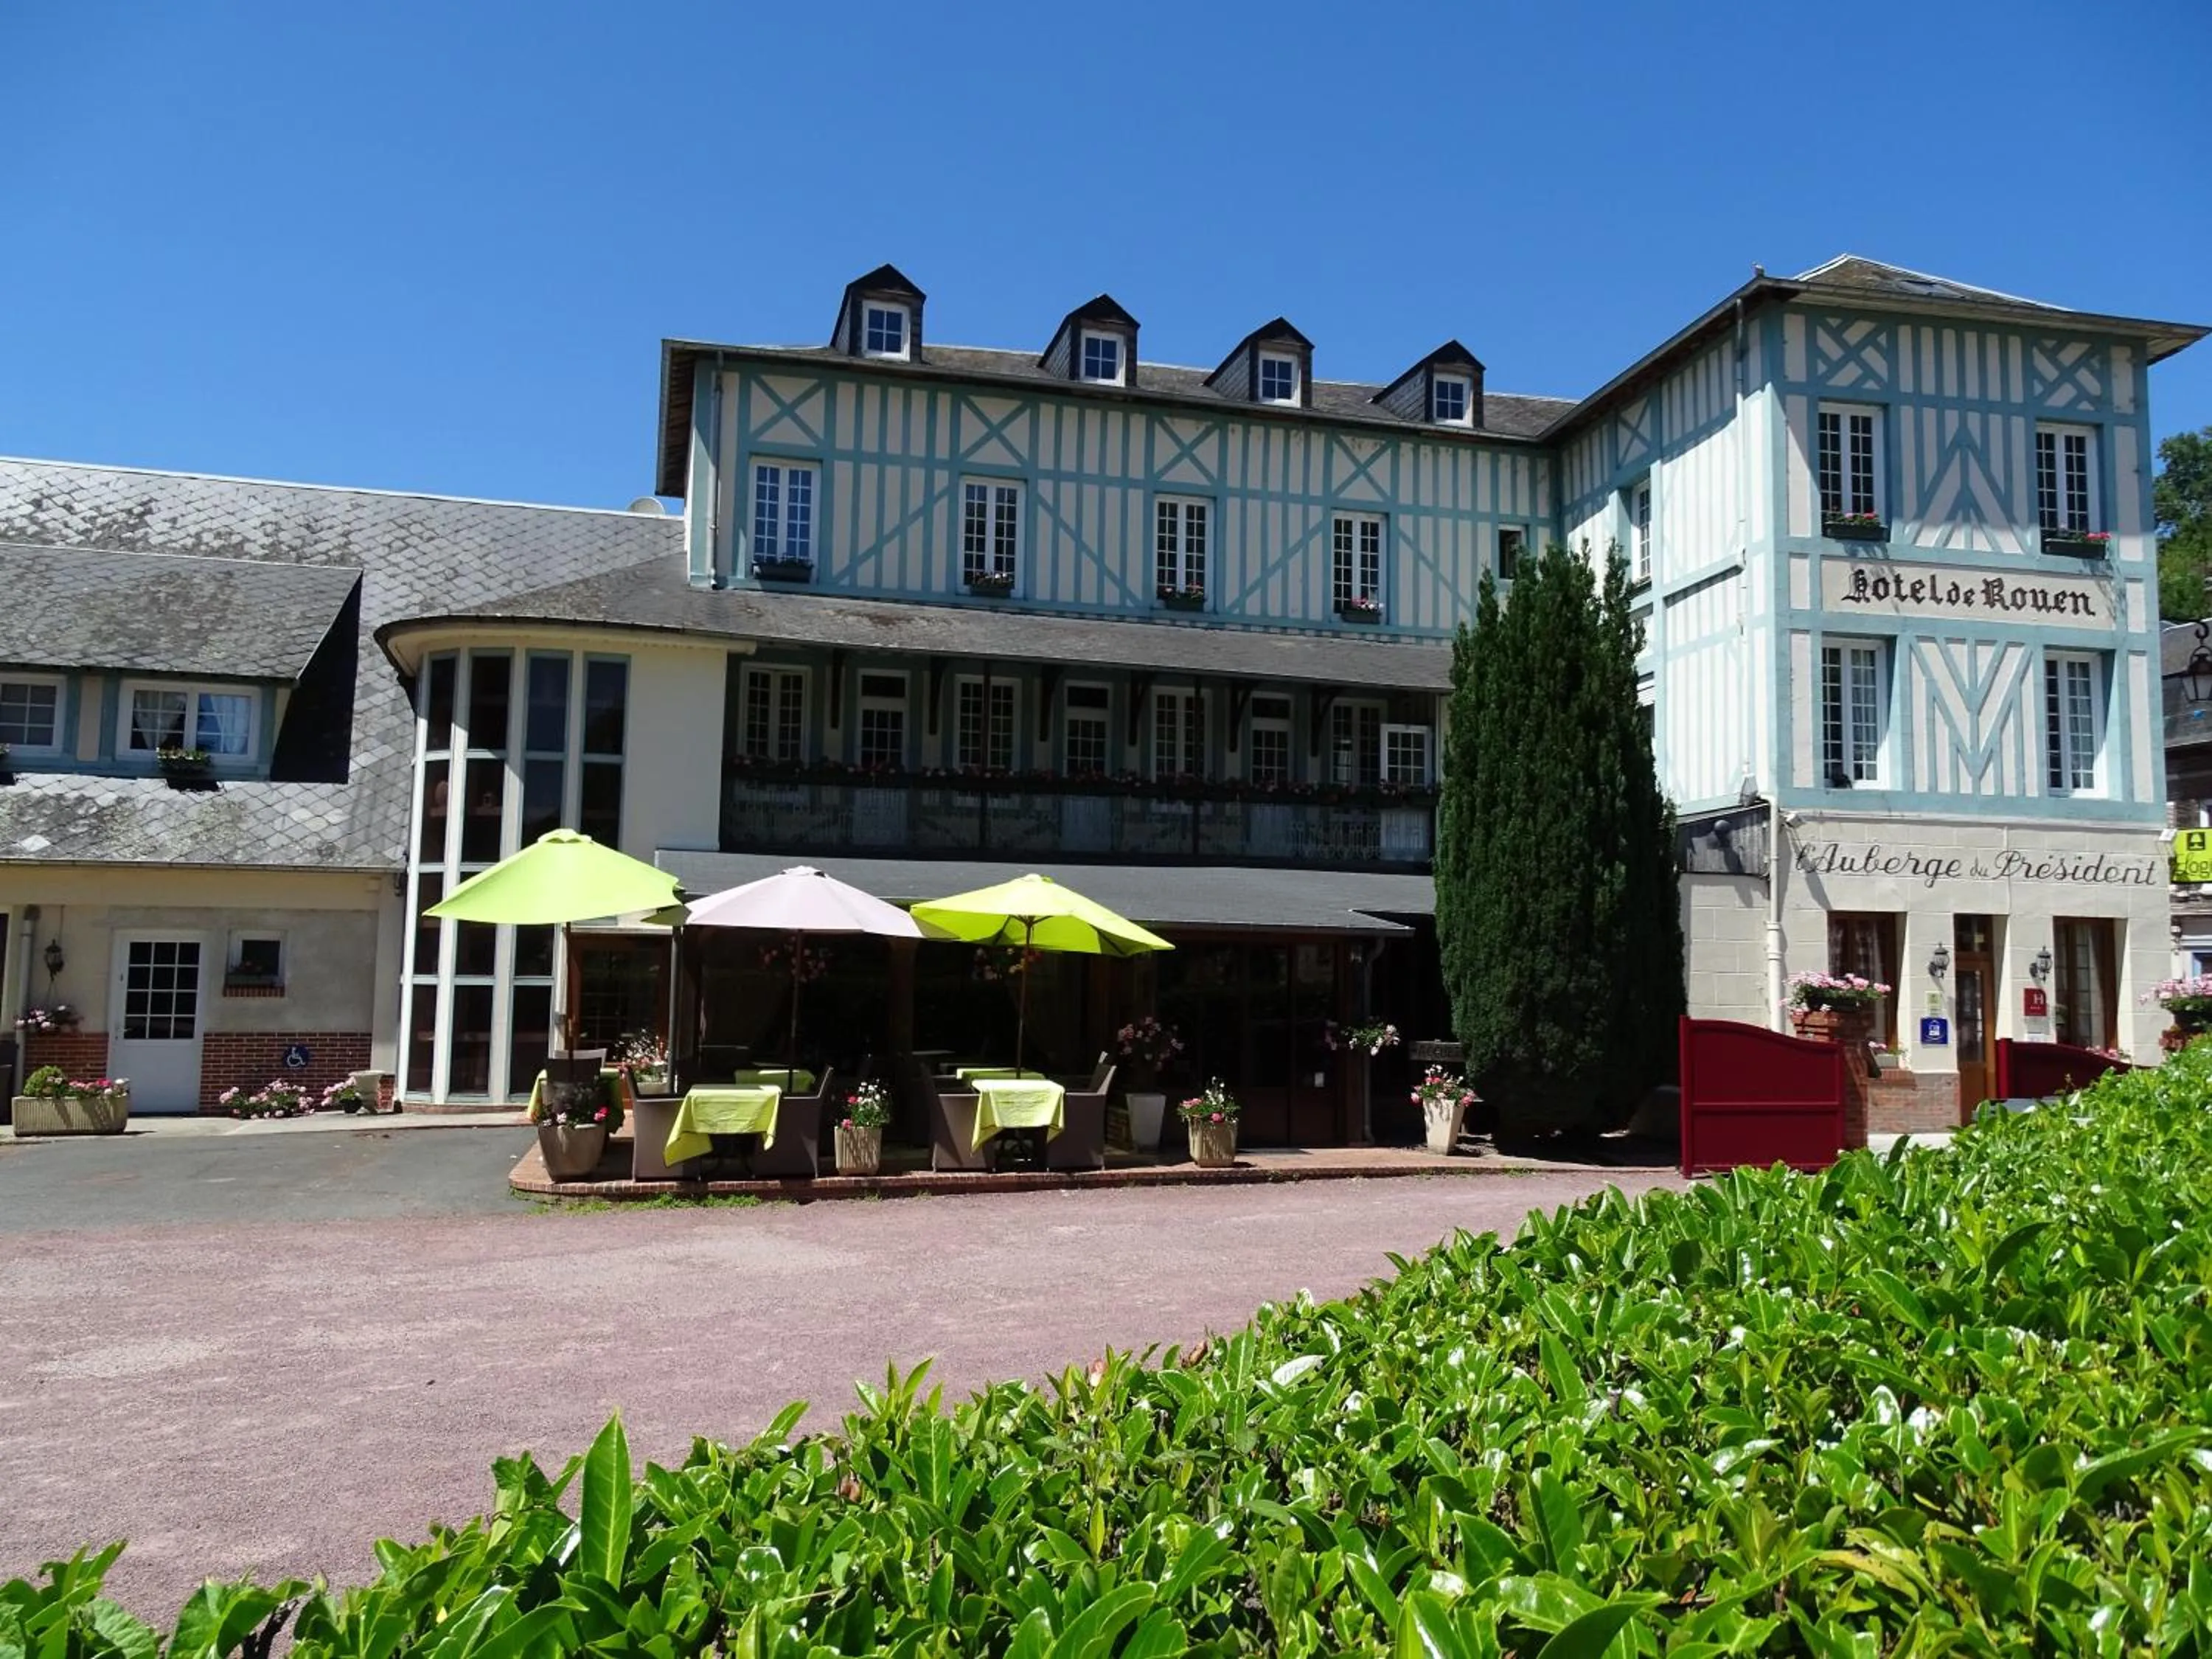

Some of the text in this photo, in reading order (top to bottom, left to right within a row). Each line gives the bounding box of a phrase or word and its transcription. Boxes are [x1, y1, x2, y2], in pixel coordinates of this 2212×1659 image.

[1947, 581, 1975, 607] de
[1981, 577, 2096, 616] Rouen
[1969, 856, 1989, 877] du
[1992, 850, 2157, 885] Président
[2034, 993, 2044, 1004] H
